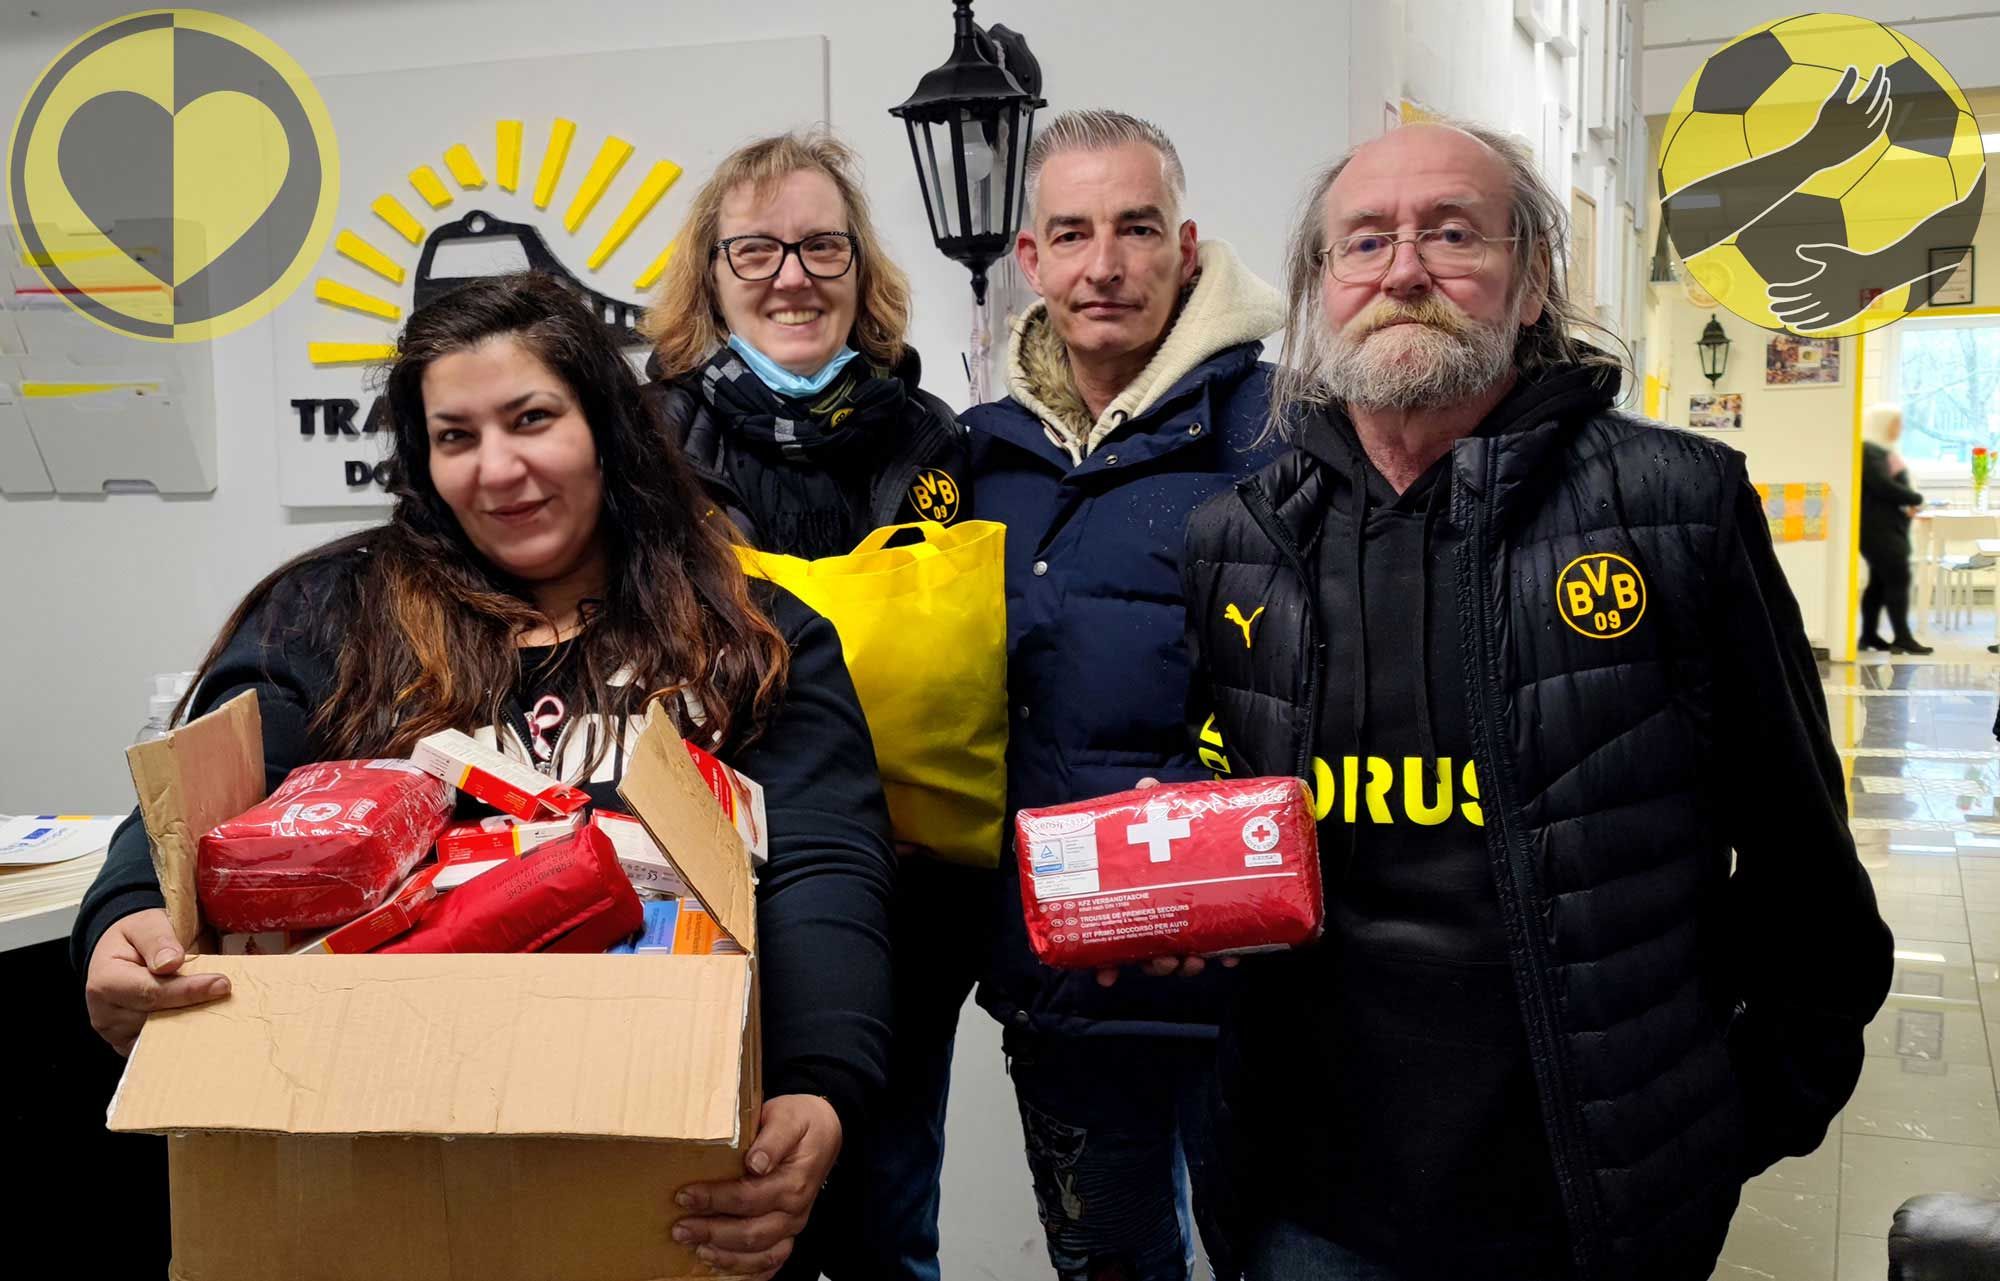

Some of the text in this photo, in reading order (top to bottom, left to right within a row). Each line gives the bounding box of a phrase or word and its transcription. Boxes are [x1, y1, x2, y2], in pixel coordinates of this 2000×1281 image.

[913, 472, 955, 510] BVB
[933, 504, 948, 520] 09
[1566, 559, 1639, 617] BVB
[1593, 609, 1622, 632] 09
[1116, 925, 1153, 935] SOCCORSO
[1170, 920, 1188, 929] AUTO
